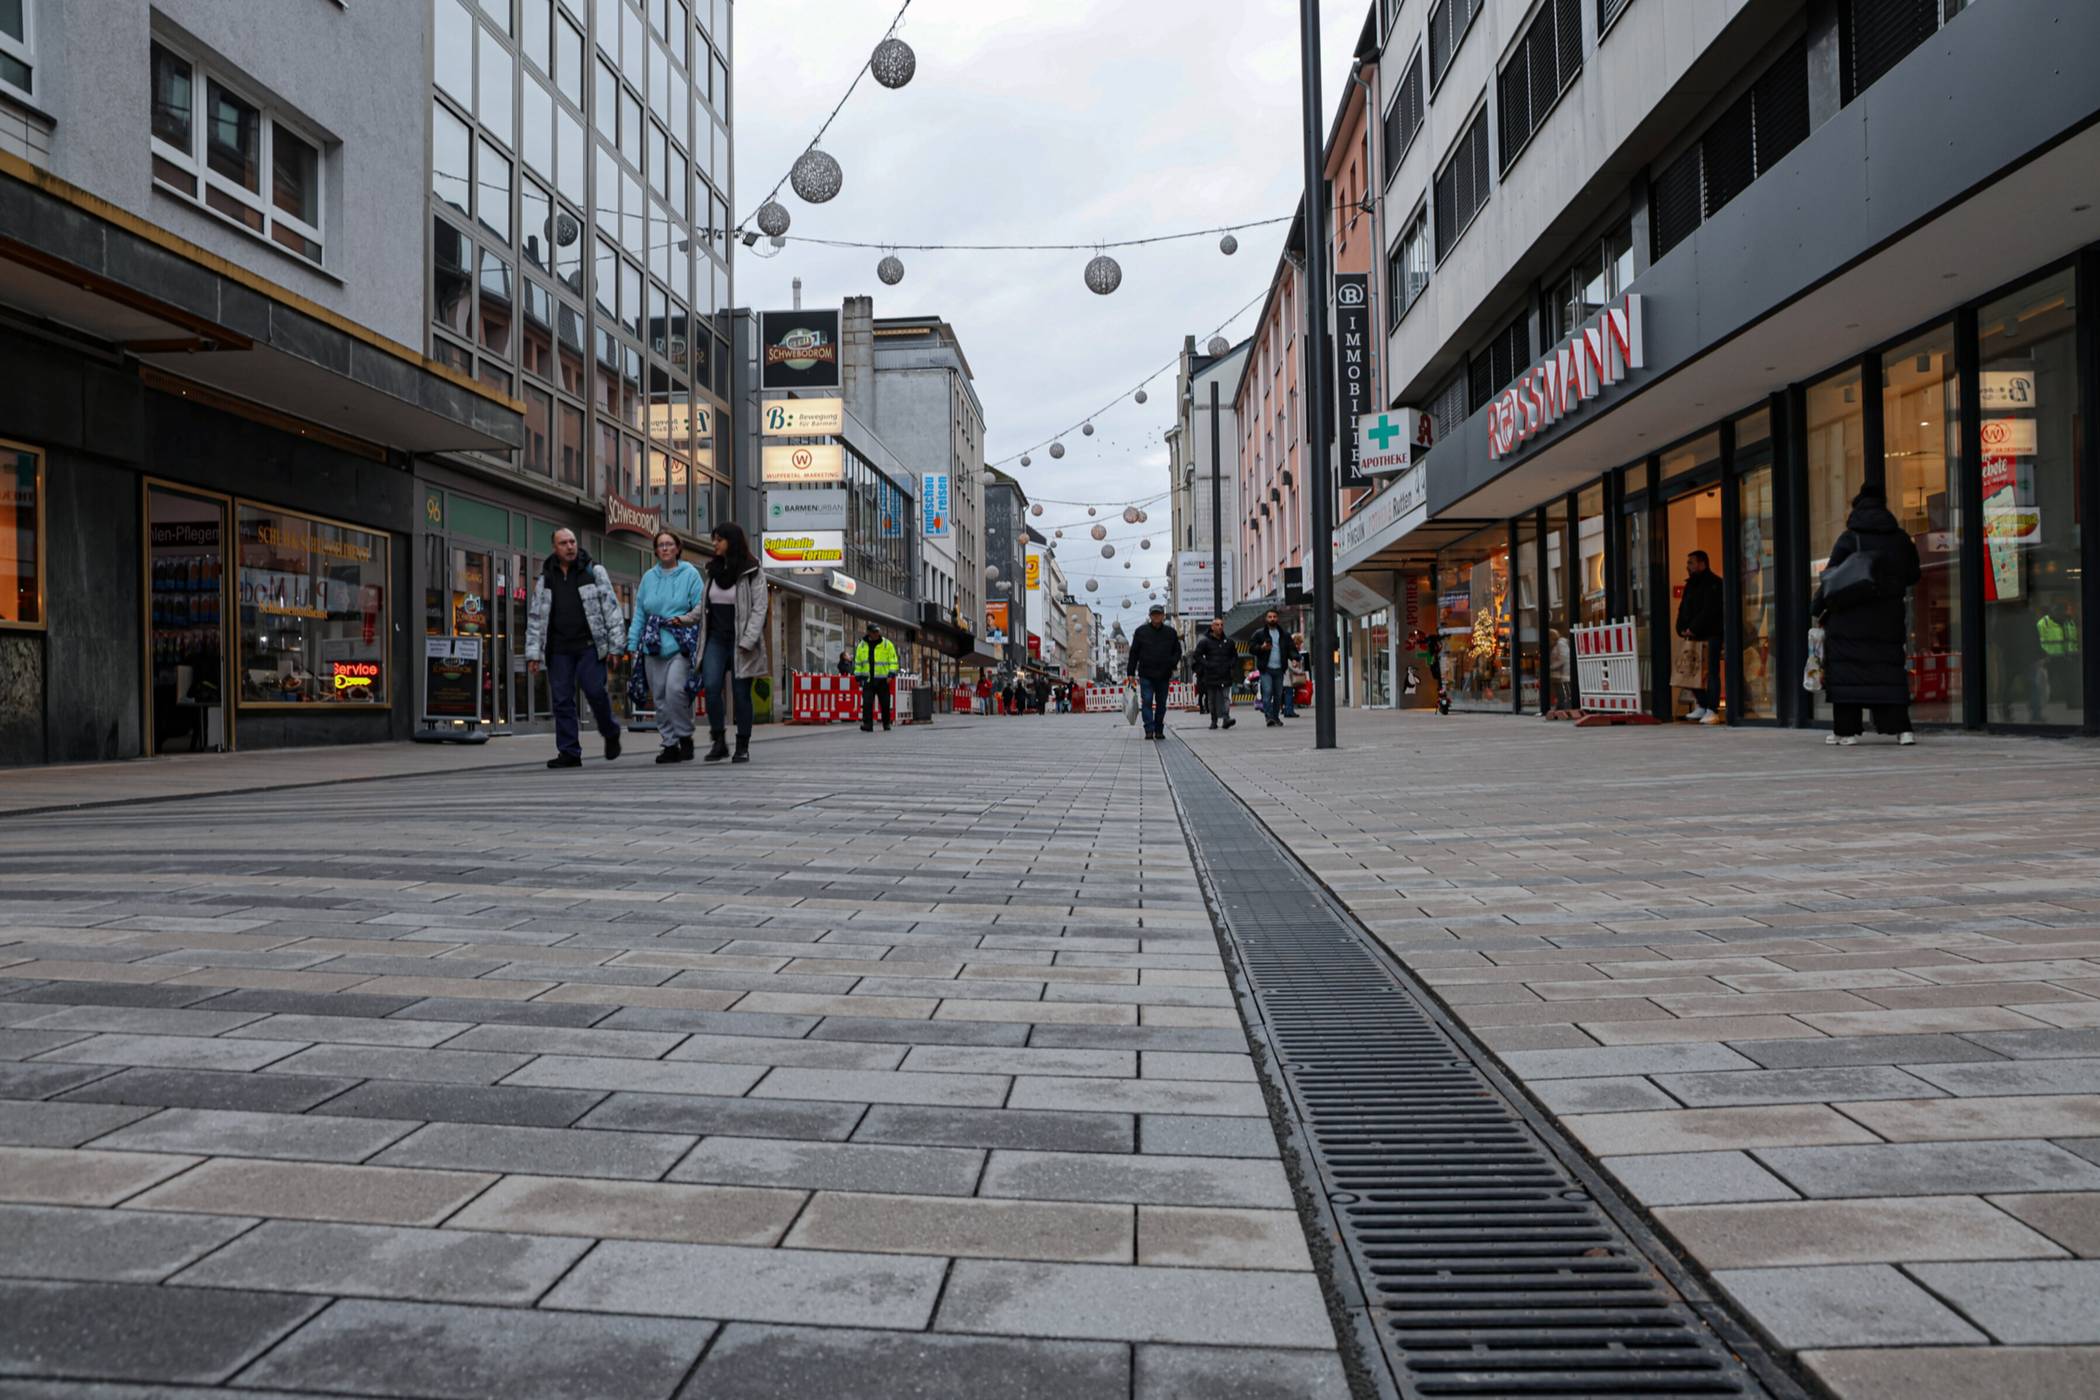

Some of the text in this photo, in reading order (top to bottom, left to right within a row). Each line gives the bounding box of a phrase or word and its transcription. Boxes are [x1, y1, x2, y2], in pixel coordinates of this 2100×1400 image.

[768, 347, 832, 361] SCHWEBODROM
[1488, 294, 1643, 460] ROSSMANN
[1345, 316, 1362, 479] IMMOBILIEN
[1361, 453, 1407, 469] APOTHEKE
[766, 471, 838, 480] WUPPERTAL MARKETING
[938, 476, 947, 510] reisen
[426, 497, 441, 522] 96
[924, 476, 934, 534] rundschau
[608, 495, 660, 537] SCHWEBODROM
[763, 537, 815, 551] Spielhalle
[801, 548, 842, 561] Fortuna
[333, 662, 378, 676] Service
